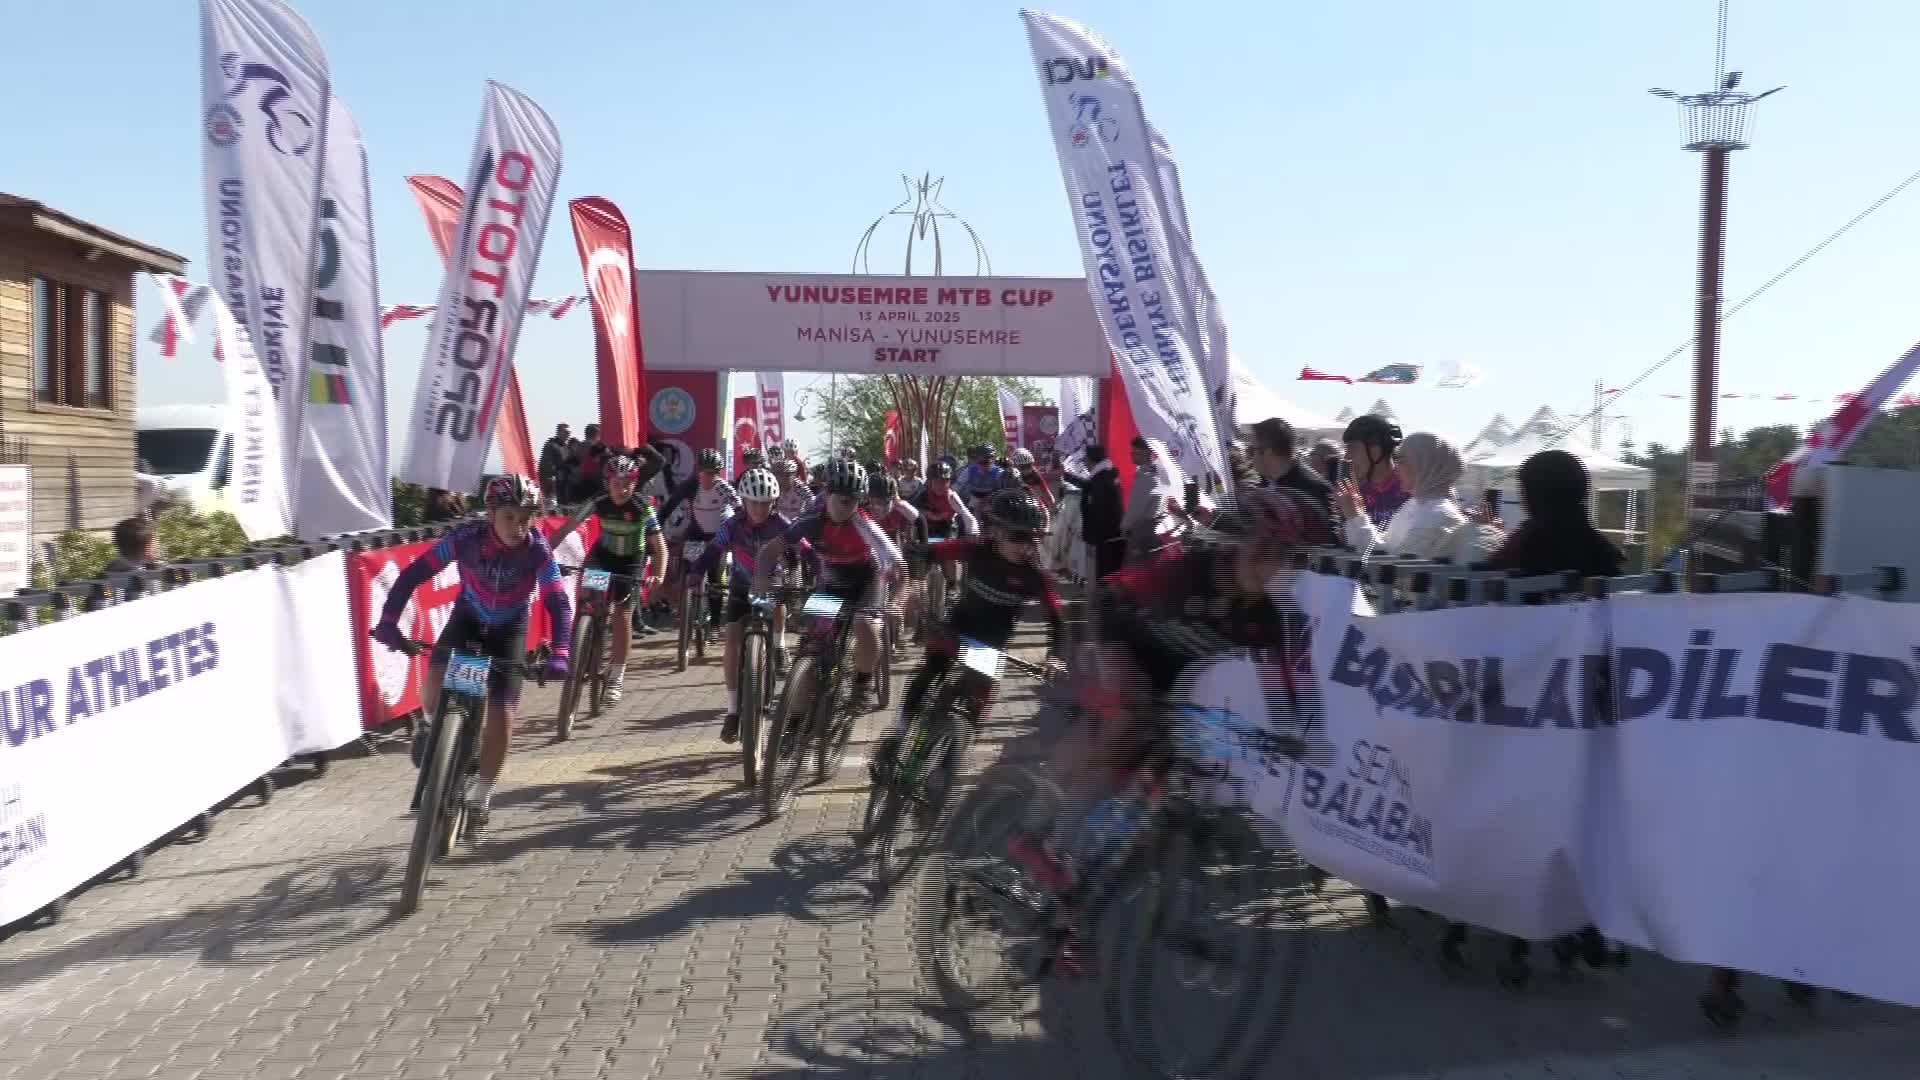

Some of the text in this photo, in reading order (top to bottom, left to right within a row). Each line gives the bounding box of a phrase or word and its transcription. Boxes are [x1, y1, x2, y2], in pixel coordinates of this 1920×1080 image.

[767, 285, 1056, 308] YUNUSEMRE MTB CUP
[858, 311, 873, 322] 13
[924, 311, 961, 323] 2025
[797, 325, 875, 343] MANİSA
[896, 328, 1022, 345] YUNUSEMRE
[874, 347, 941, 363] START
[65, 622, 218, 727] ATHLETES
[1619, 630, 1920, 744] DİLER
